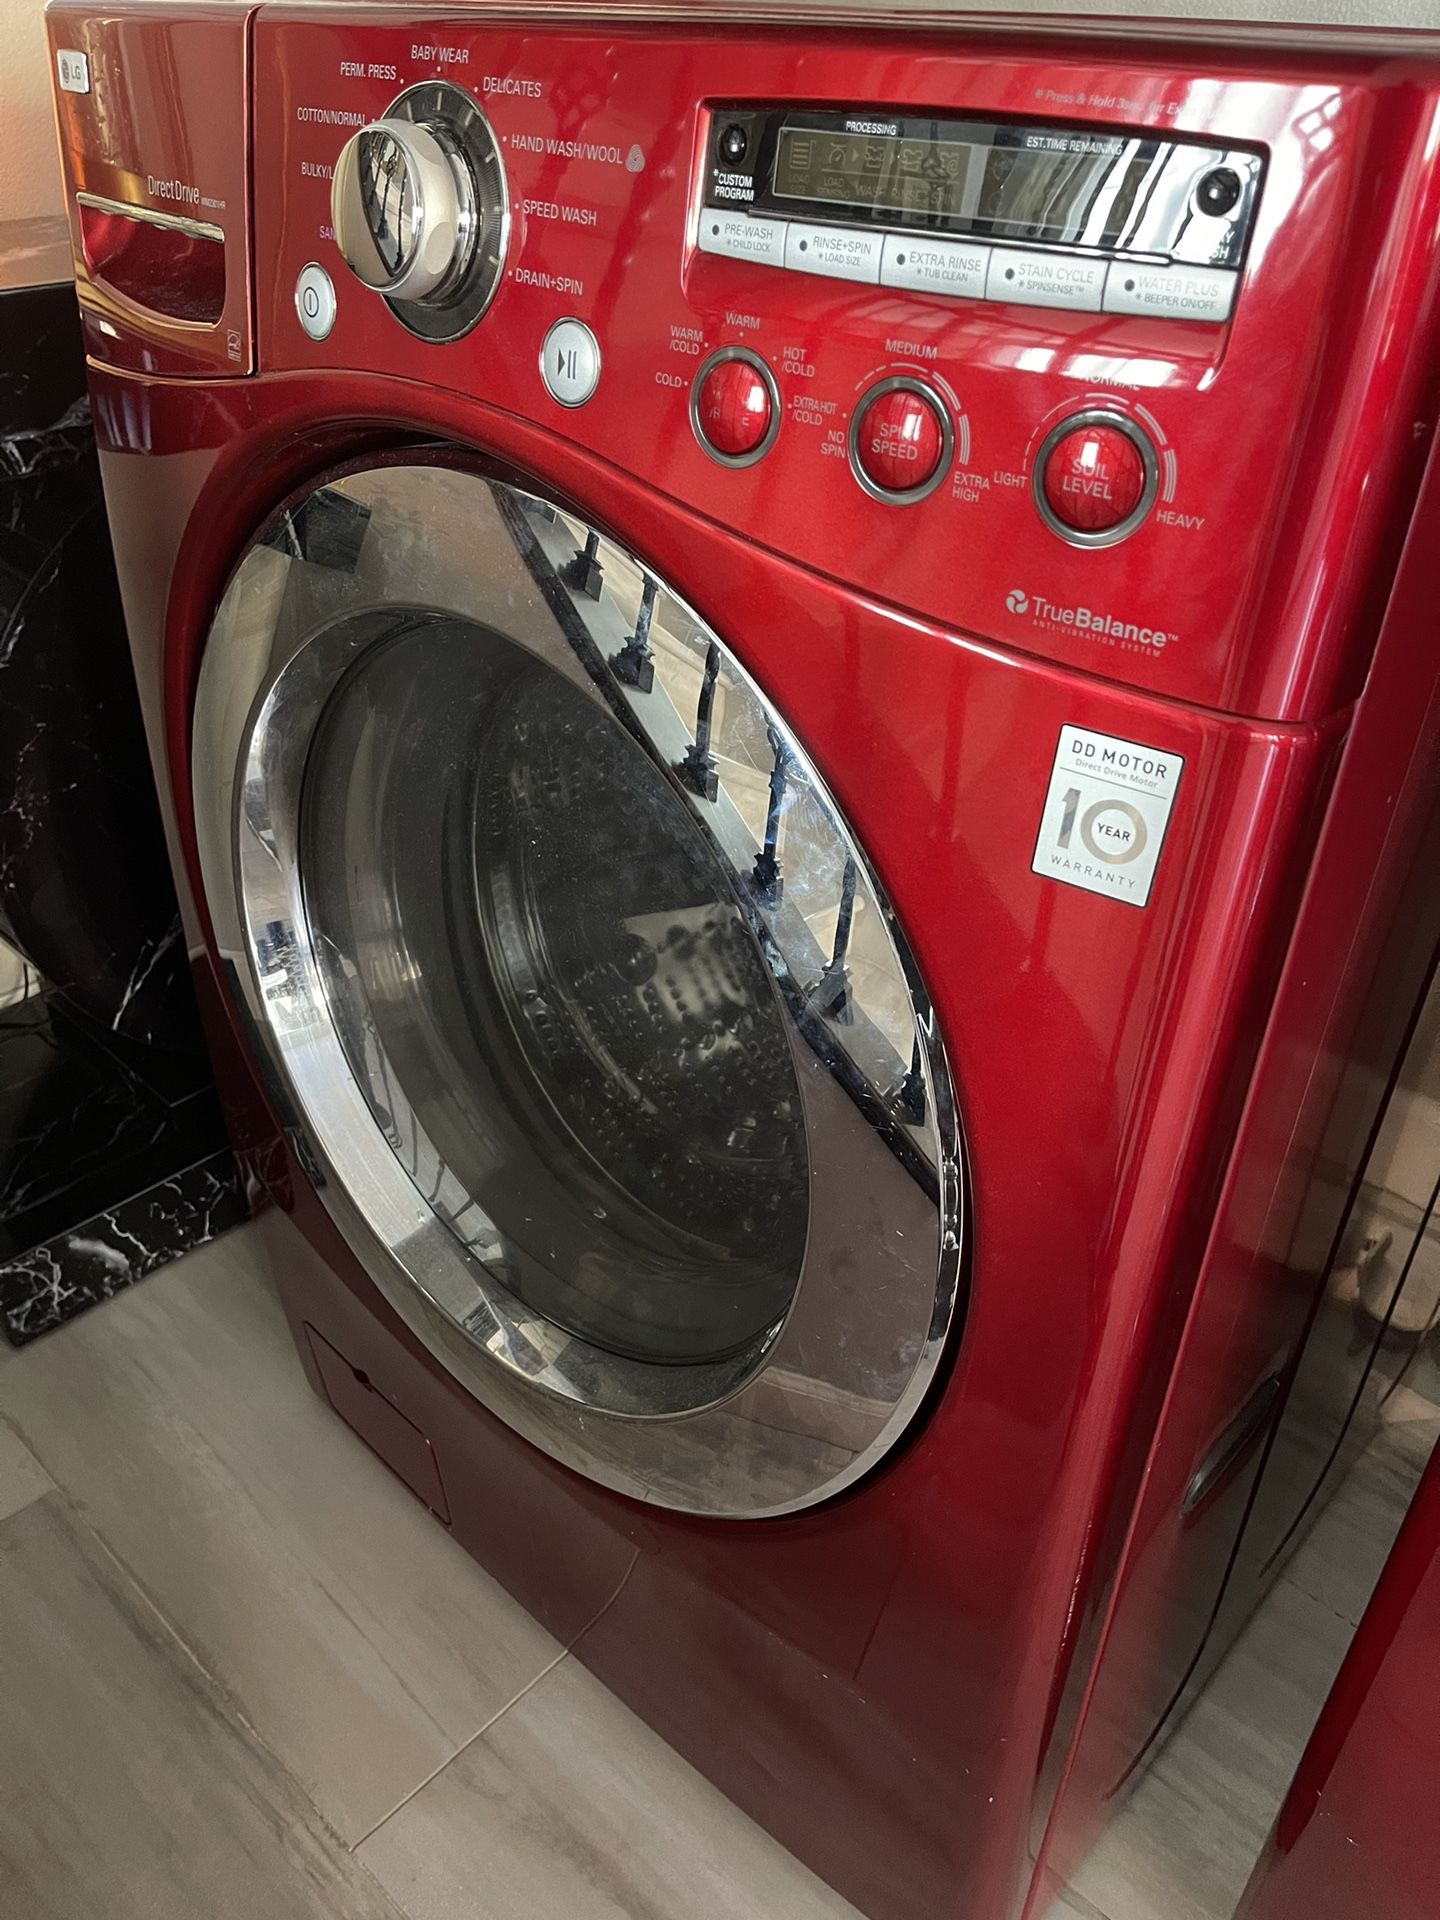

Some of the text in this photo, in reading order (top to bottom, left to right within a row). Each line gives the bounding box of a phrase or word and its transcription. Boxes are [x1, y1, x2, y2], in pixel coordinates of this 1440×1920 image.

[411, 45, 469, 64] BABY WEAR
[71, 62, 82, 80] LG
[340, 62, 397, 80] PERM. PRESS
[483, 76, 542, 97] DELICATES
[297, 107, 367, 127] COTTON/NORMAL
[846, 121, 897, 136] PROCESSING
[511, 134, 623, 164] HAND WASH/WOOL
[1069, 139, 1123, 157] REMAINING
[301, 161, 334, 180] BULKY/L
[718, 173, 753, 188] CUSTOM
[714, 186, 754, 201] PROGRAM
[523, 199, 597, 226] SPEED WASH
[724, 223, 773, 240] PRE-WASH
[732, 240, 771, 251] CHILD LOCK
[813, 235, 872, 255] RINSE+SPIN
[824, 252, 862, 266] LOAD SIZE
[909, 251, 982, 272] EXTRA RINSE
[515, 267, 583, 296] DRAIN+SPIN
[924, 268, 969, 282] TUB CLEAN
[1018, 263, 1094, 284] STAIN CYCLE
[1138, 275, 1220, 297] WATER PLUS
[1144, 293, 1217, 311] BEEPER ON/OFF
[725, 312, 761, 330] WARM
[670, 325, 703, 342] WARM
[669, 340, 700, 356] /COLD
[783, 346, 807, 361] HOT
[885, 339, 938, 360] MEDIUM
[781, 360, 815, 378] /COLD
[655, 371, 682, 388] COLD
[793, 395, 838, 415] EXTRA HOT
[792, 410, 823, 426] /COLD
[827, 430, 845, 443] NO
[820, 442, 846, 459] SPIN
[871, 438, 918, 461] SPEED
[1071, 458, 1110, 481] SOIL
[953, 471, 990, 490] EXTRA
[993, 471, 1028, 489] LIGHT
[1062, 476, 1113, 500] LEVEL
[952, 486, 980, 503] HIGH
[1156, 509, 1205, 531] HEAVY
[1032, 618, 1161, 658] ANTI-VIBRATION SYSTEM
[1071, 739, 1168, 779] DD MOTOR
[1075, 758, 1158, 789] Direct Drive Motor
[1057, 787, 1148, 865] 10
[1097, 822, 1131, 842] YEAR
[1050, 854, 1136, 889] WARRANTY
